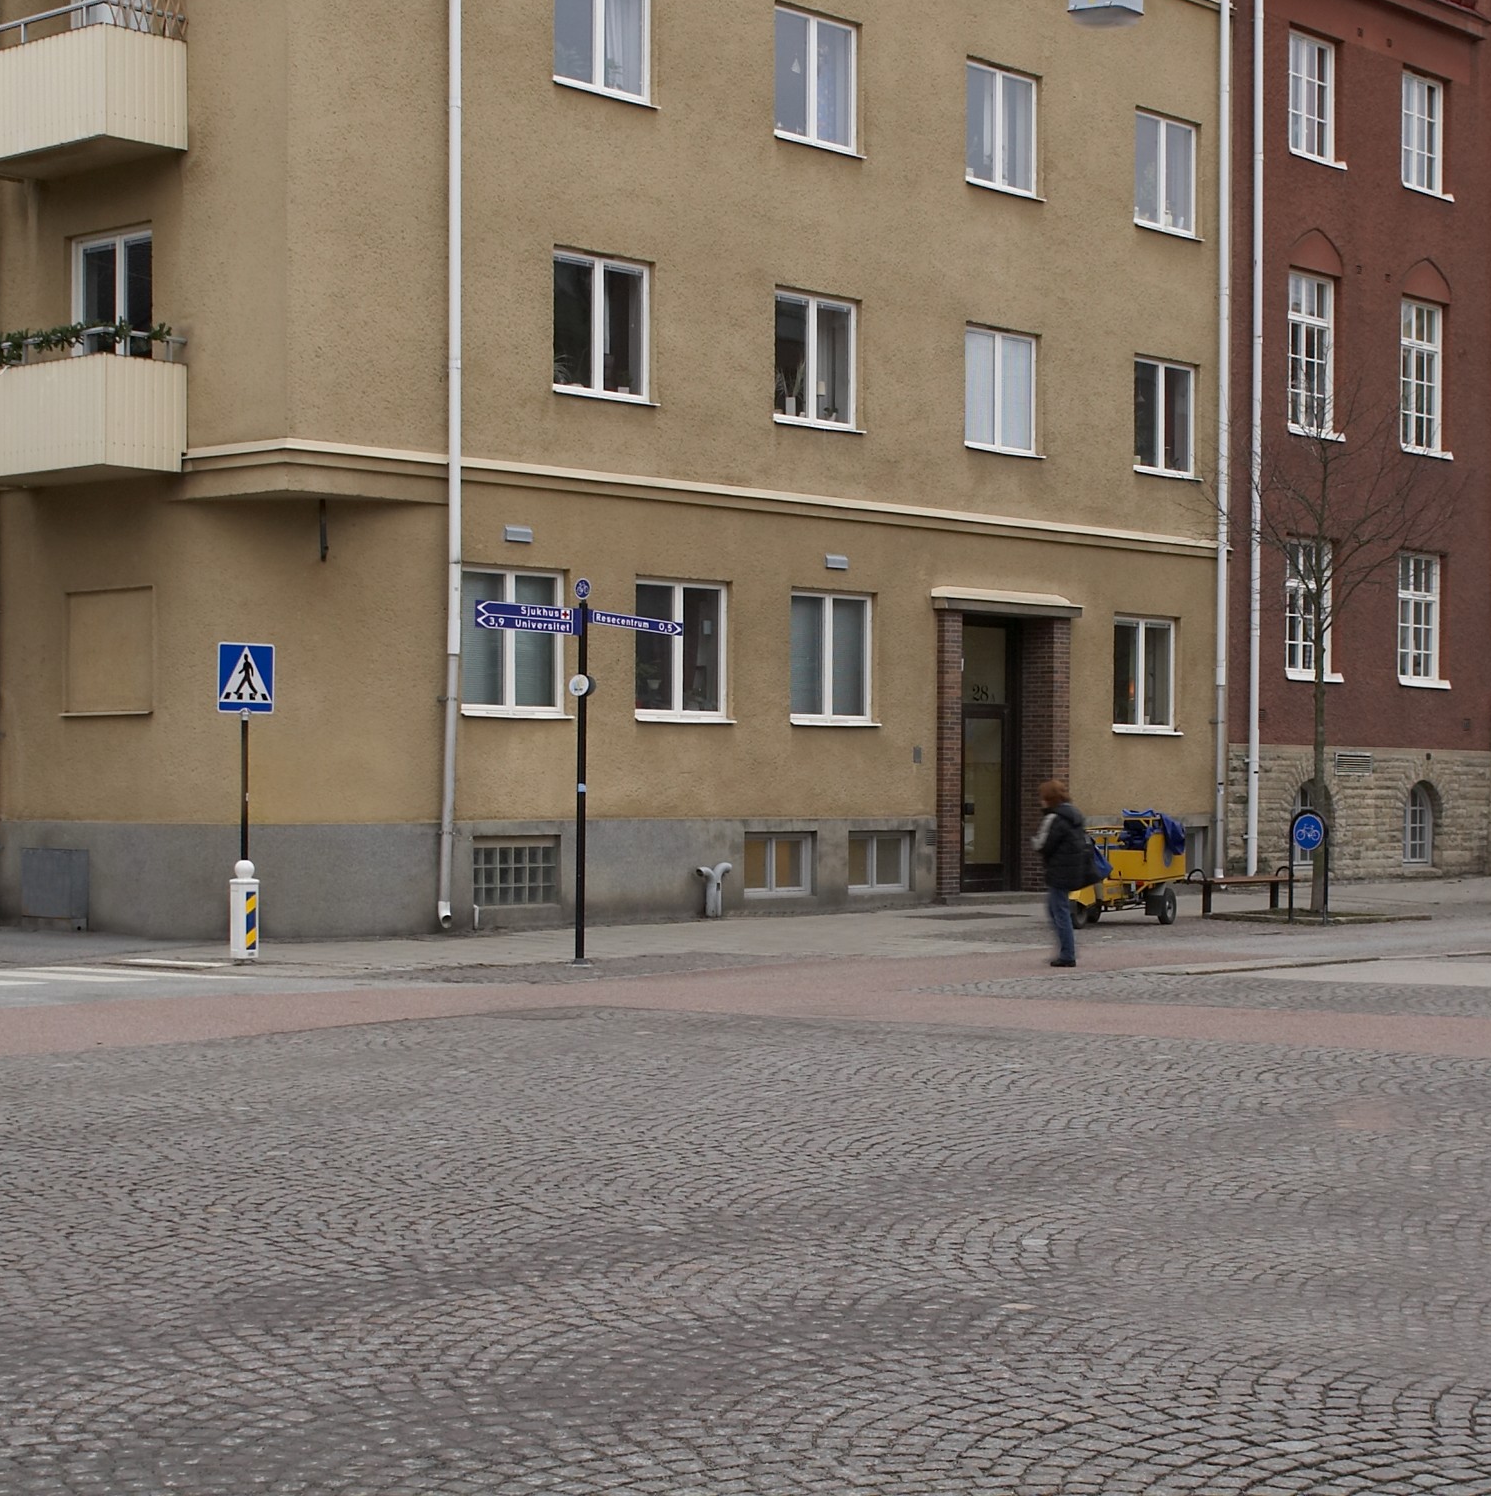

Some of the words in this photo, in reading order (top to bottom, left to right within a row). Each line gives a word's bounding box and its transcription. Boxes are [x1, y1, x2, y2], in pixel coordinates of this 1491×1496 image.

[520, 606, 560, 617] Sjukhus
[489, 616, 505, 627] 3,9
[515, 619, 570, 631] Universitet
[595, 613, 650, 629] Resecentrum
[658, 622, 673, 633] 0,5
[972, 684, 989, 702] 28
